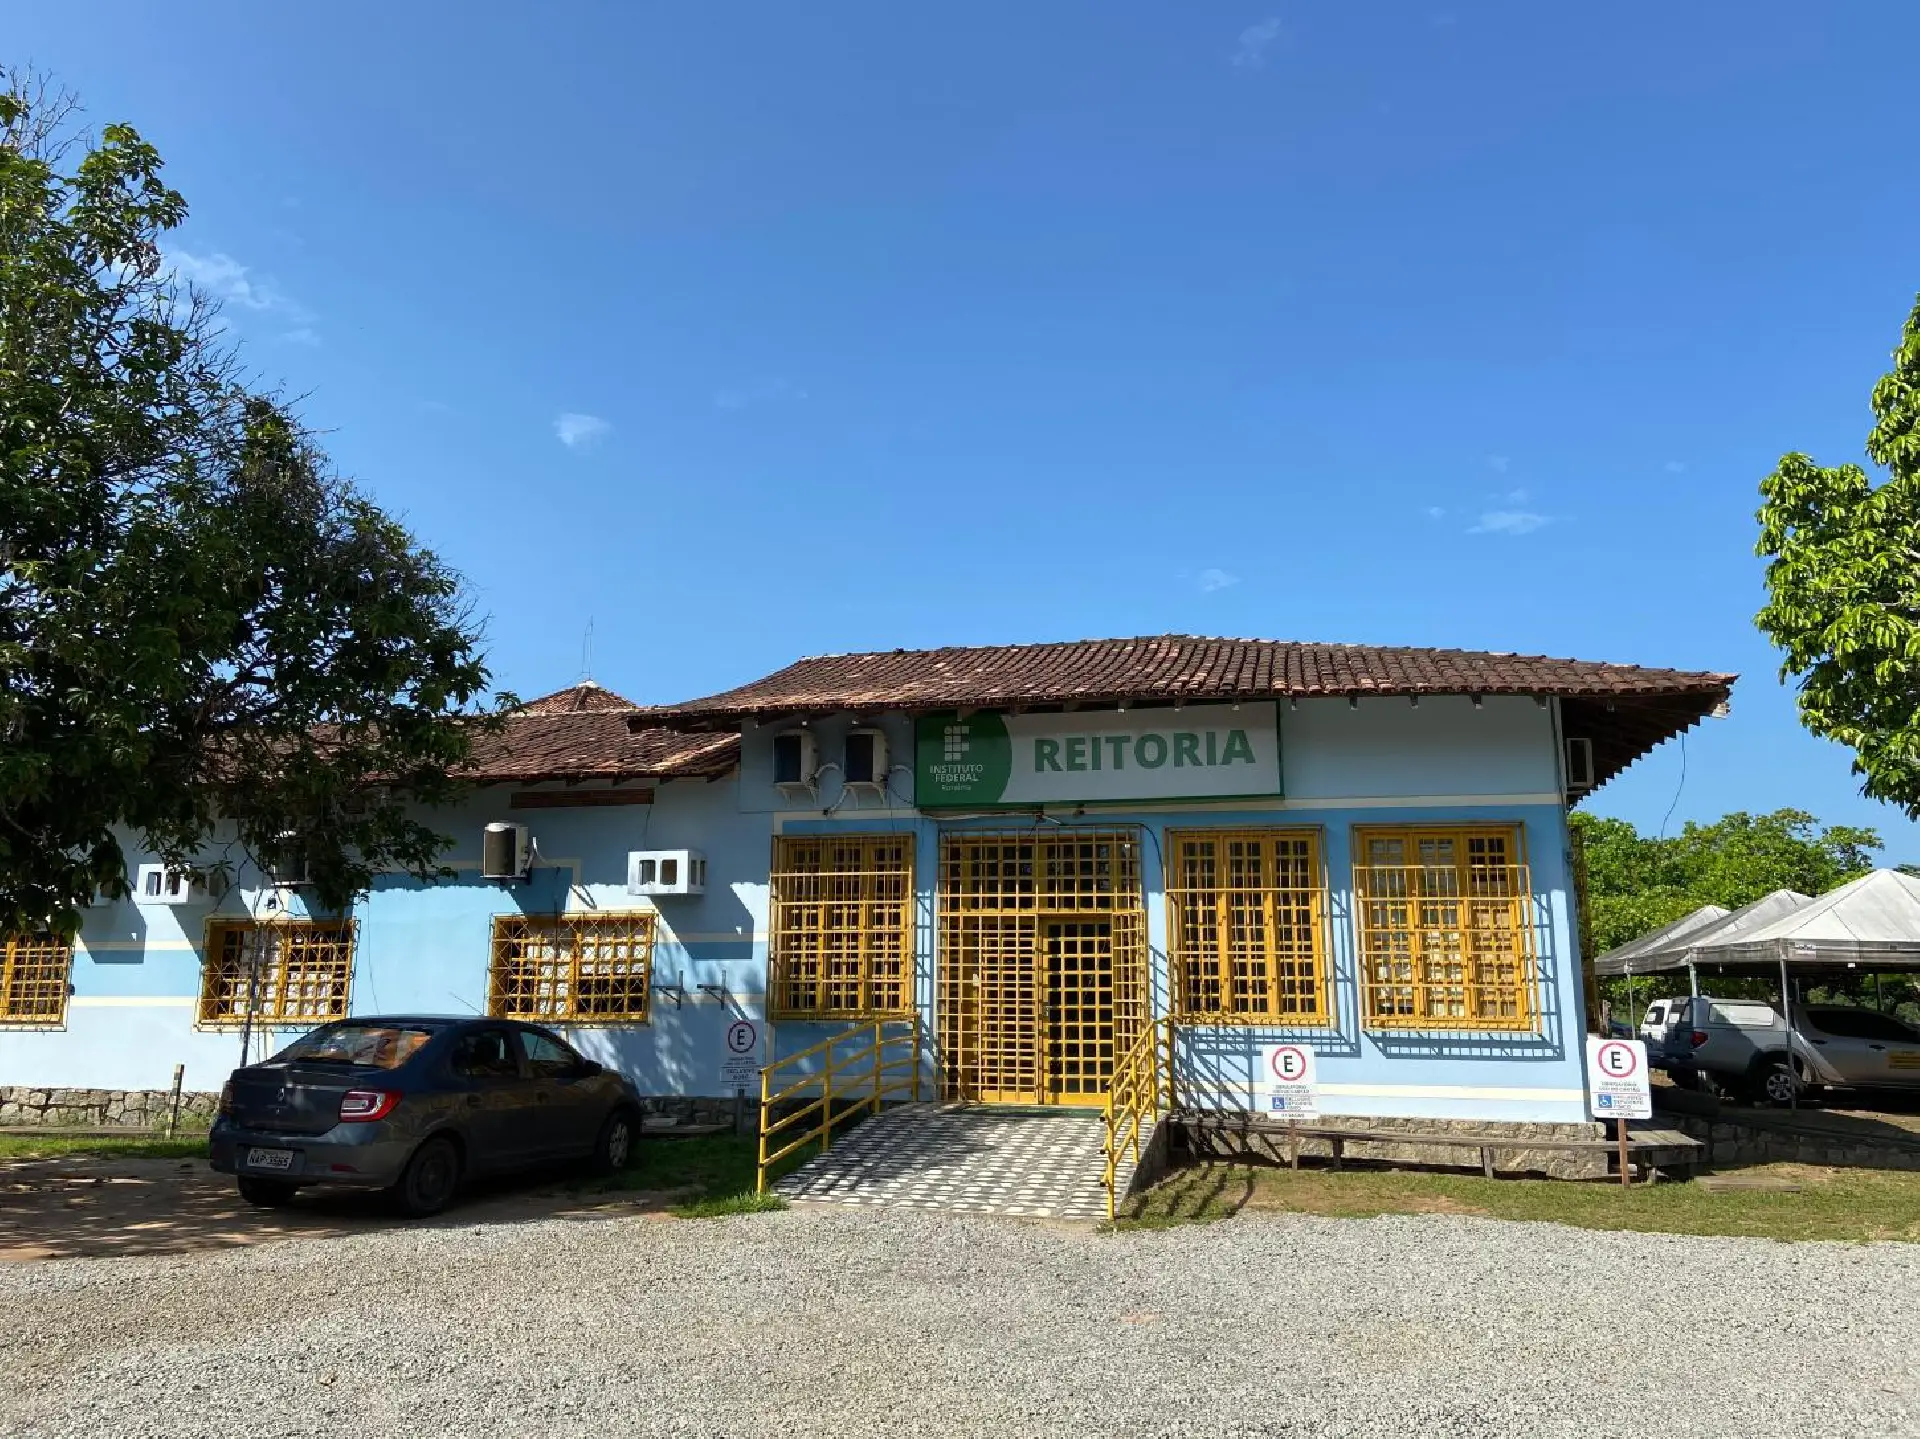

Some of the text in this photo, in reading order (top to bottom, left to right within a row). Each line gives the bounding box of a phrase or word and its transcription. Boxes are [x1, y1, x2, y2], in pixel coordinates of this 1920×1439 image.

[1034, 729, 1256, 773] REITORIA
[929, 764, 984, 774] INSTITUTO
[935, 773, 979, 783] FEDERAL
[736, 1028, 746, 1046] E
[1283, 1055, 1294, 1073] E
[1610, 1051, 1623, 1070] E
